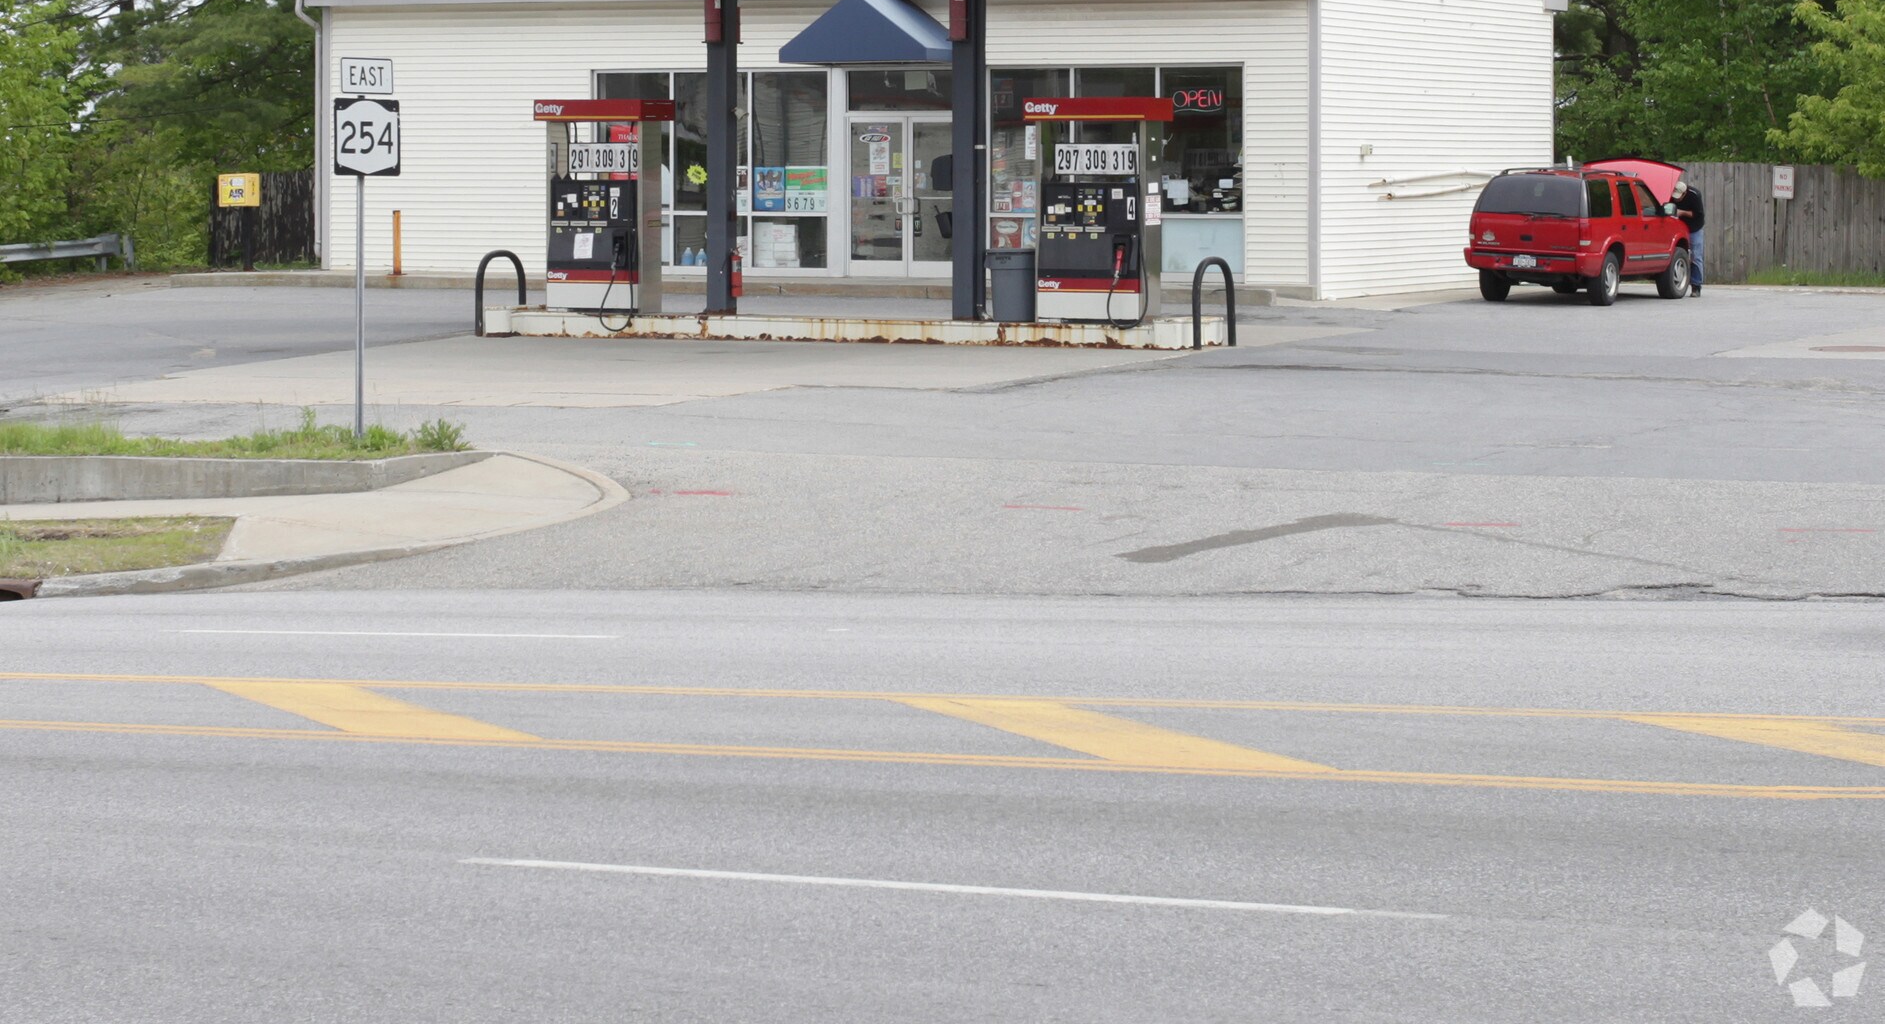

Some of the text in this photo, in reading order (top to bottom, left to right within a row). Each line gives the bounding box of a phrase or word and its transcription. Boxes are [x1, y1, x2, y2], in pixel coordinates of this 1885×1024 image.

[349, 65, 384, 87] EAST
[1024, 101, 1057, 115] Getty
[1172, 89, 1222, 108] OPEN
[534, 102, 563, 115] Getty
[341, 120, 394, 154] 254
[571, 148, 590, 169] 297
[595, 148, 614, 168] 309
[1057, 148, 1134, 171] 297 309 319
[228, 188, 244, 198] AIR
[611, 198, 617, 218] 2
[1128, 198, 1135, 219] 4
[547, 271, 568, 280] Getty
[1038, 279, 1061, 289] Getty
